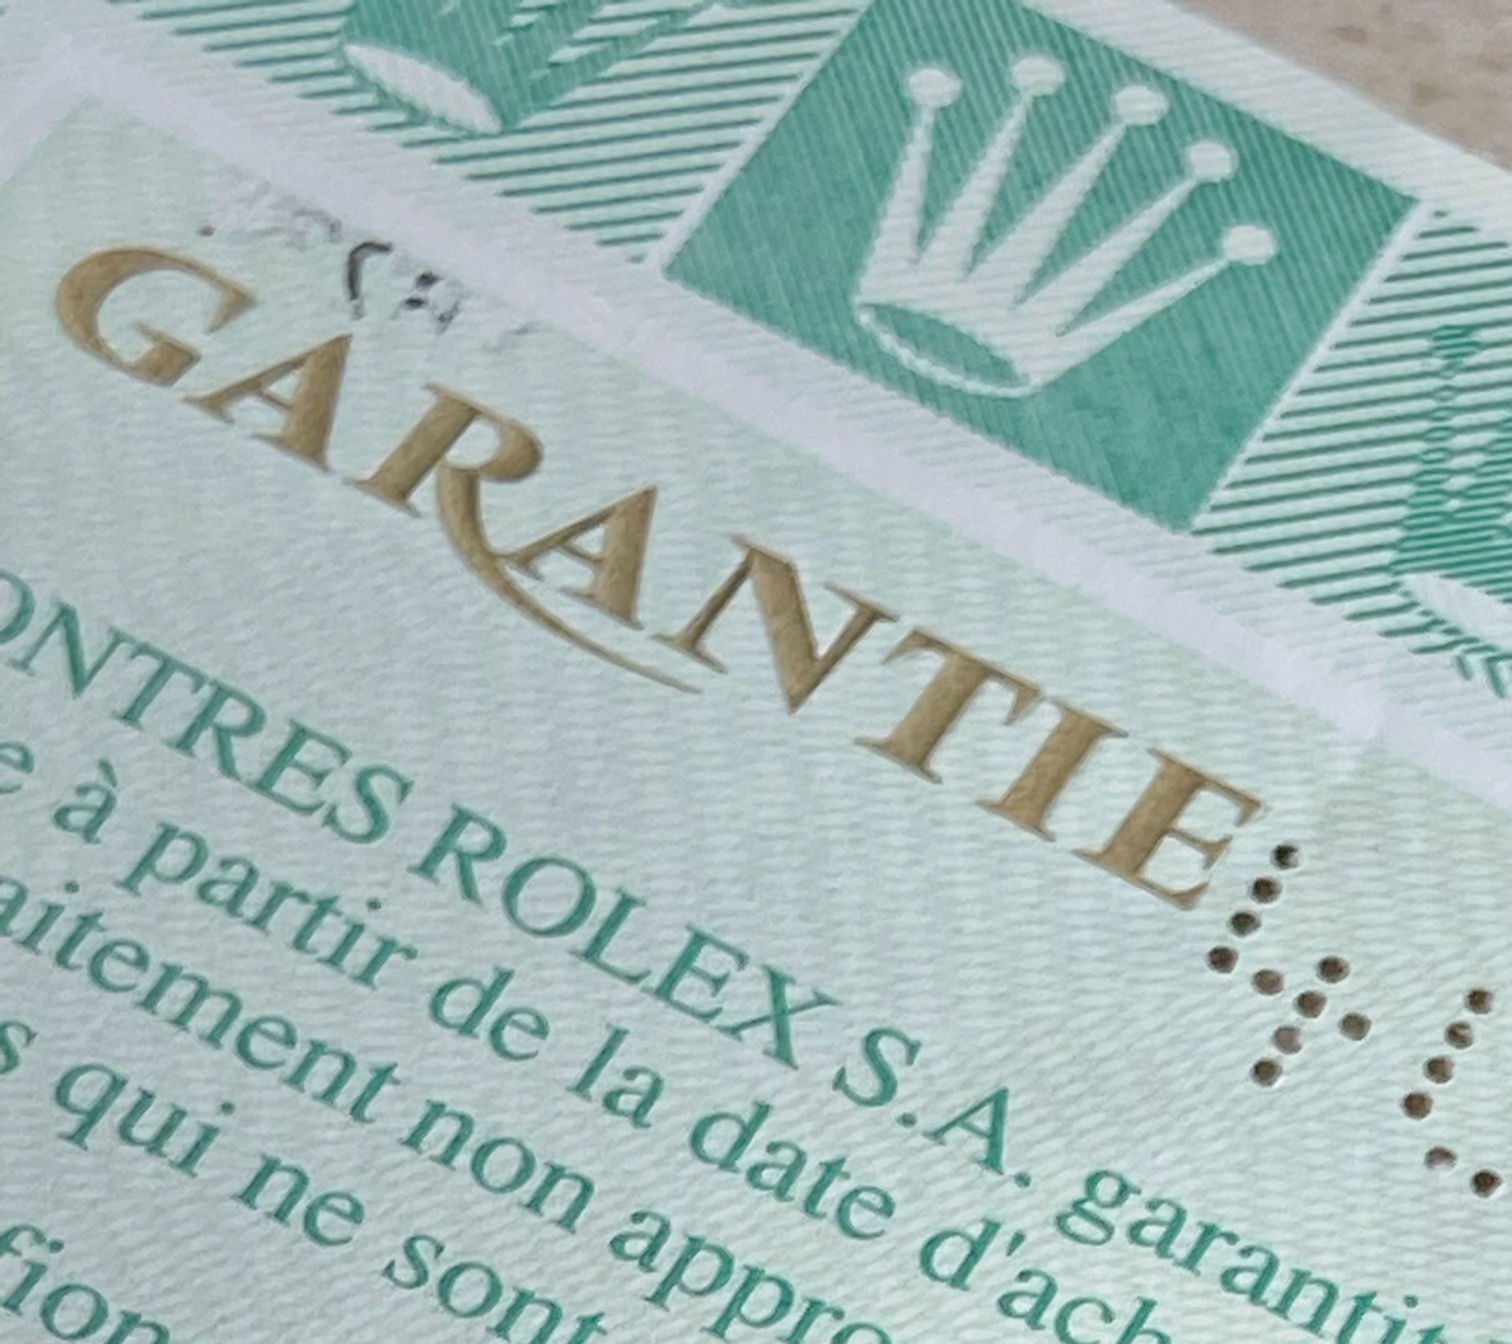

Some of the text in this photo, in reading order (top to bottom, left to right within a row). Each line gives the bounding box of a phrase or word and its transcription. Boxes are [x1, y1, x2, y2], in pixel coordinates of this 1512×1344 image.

[55, 245, 1263, 909] GARANTIE
[53, 759, 118, 845] à
[115, 822, 418, 989] partir
[429, 967, 549, 1062] de
[567, 1025, 665, 1128] la
[690, 1101, 895, 1240] date
[53, 1064, 236, 1178] qui
[233, 1153, 365, 1246] ne
[401, 1098, 595, 1234] non
[409, 804, 841, 1068] ROLEX
[834, 1028, 1030, 1188] S.A.
